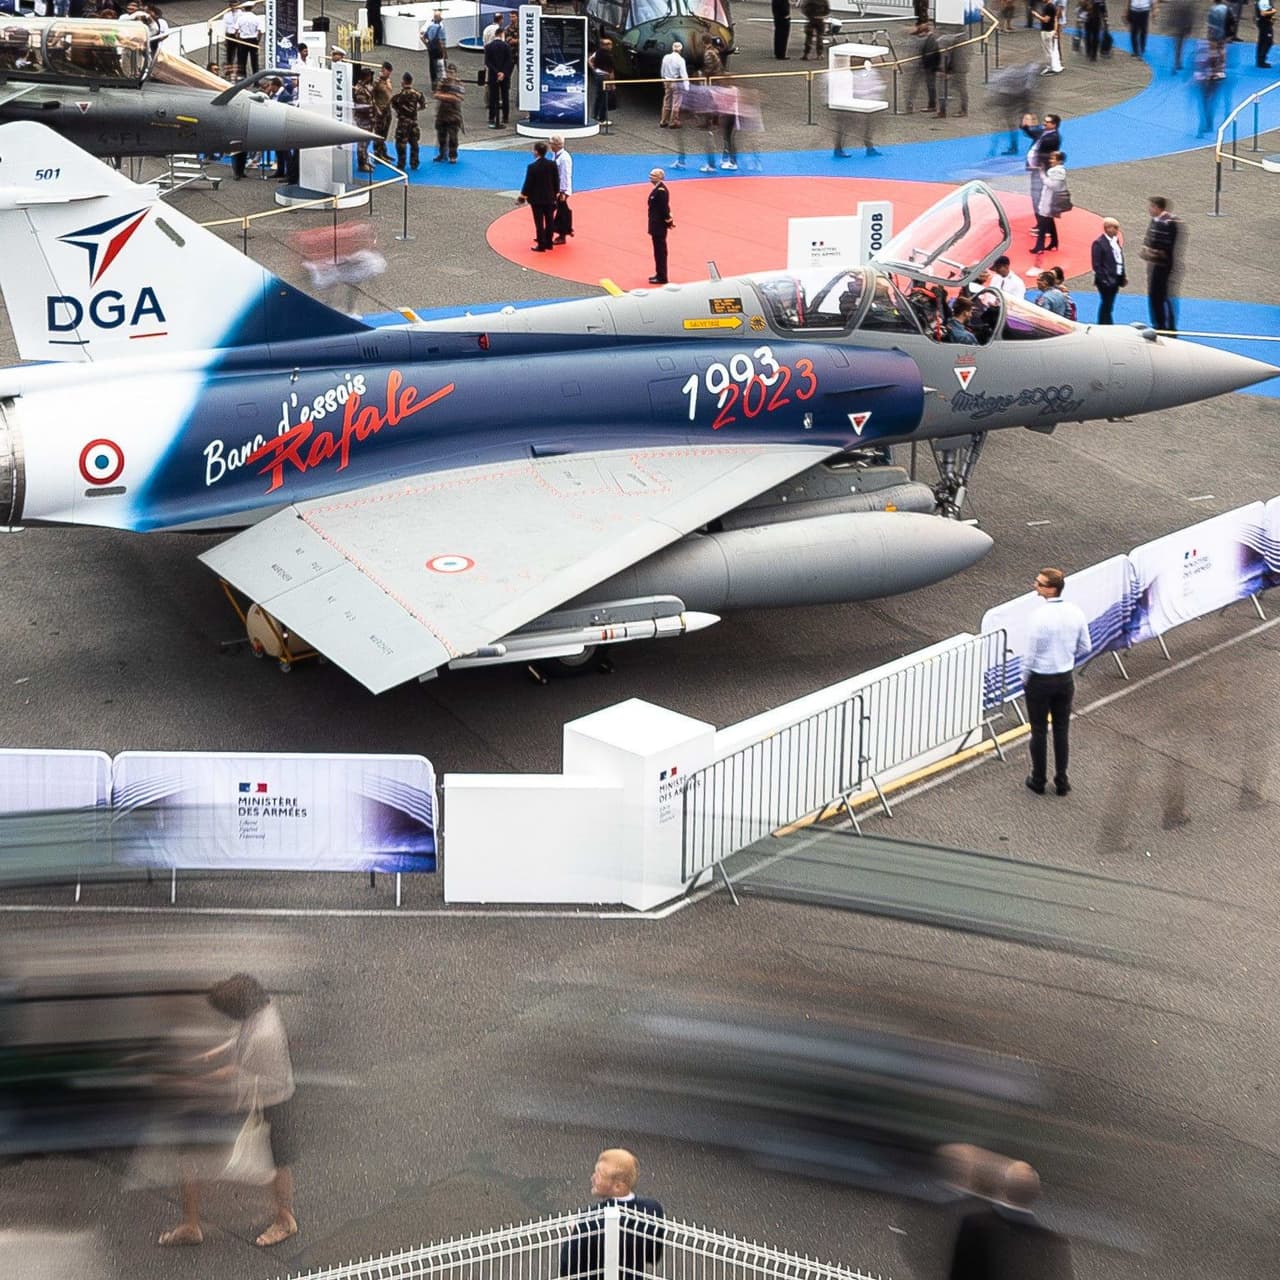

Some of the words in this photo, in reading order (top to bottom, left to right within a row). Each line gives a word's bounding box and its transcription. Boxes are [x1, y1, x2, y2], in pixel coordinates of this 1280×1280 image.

[526, 12, 535, 44] TERRE
[526, 47, 535, 92] CAIMAN
[34, 168, 61, 181] 501
[47, 286, 166, 332] DGA
[682, 345, 780, 421] 1993
[712, 358, 817, 431] 2023
[203, 433, 267, 486] Banc
[278, 373, 367, 436] d'essais
[246, 369, 456, 496] Rafale
[238, 795, 298, 807] MINISTÈRE
[238, 807, 259, 817] DES
[263, 807, 308, 817] ARMÉES
